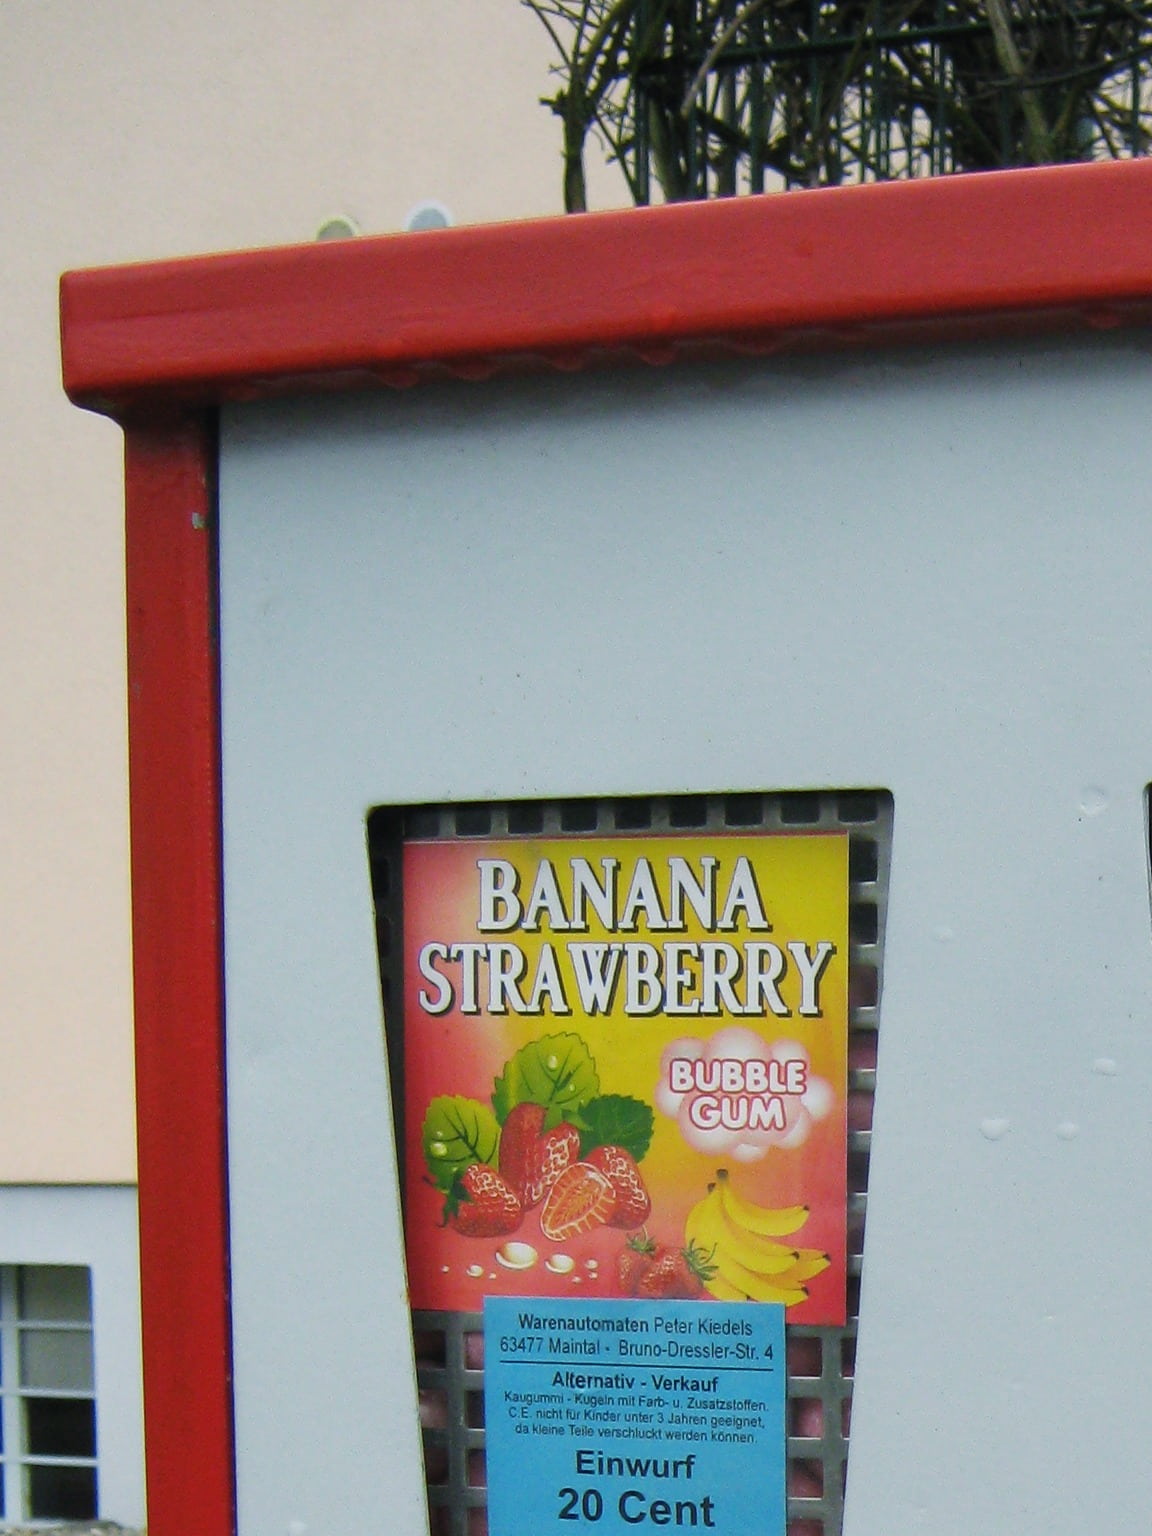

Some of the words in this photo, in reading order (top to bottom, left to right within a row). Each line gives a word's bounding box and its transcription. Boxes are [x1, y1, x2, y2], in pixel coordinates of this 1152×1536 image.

[476, 856, 773, 933] BANANA
[418, 942, 837, 1017] STRAWBERRY
[670, 1058, 807, 1095] BUBBLE
[689, 1095, 787, 1130] GUM
[519, 1313, 649, 1332] Warenautomaten
[654, 1316, 693, 1334] Peter
[698, 1318, 753, 1336] Kiedels
[500, 1336, 544, 1353] 63477
[549, 1338, 600, 1355] Maintal
[619, 1339, 760, 1361] Bruno-Dressler-Str.
[764, 1343, 774, 1361] 4
[552, 1371, 635, 1389] Alternativ
[652, 1374, 719, 1393] Verkauf
[504, 1391, 564, 1406] Kaugummi
[574, 1394, 615, 1408] Kugeln
[618, 1394, 635, 1406] mit
[638, 1396, 669, 1409] Farb-
[673, 1399, 683, 1409] u.
[687, 1397, 769, 1412] Zusatzstoffen.
[508, 1406, 532, 1419] C.E.
[536, 1407, 563, 1420] nicht
[566, 1407, 581, 1421] für
[584, 1409, 621, 1422] Kinder
[624, 1411, 654, 1424] unter
[656, 1412, 665, 1424] 3
[668, 1412, 707, 1426] Jahren
[711, 1414, 765, 1430] geeignet,
[515, 1422, 529, 1434] da
[532, 1423, 565, 1436] kleine
[568, 1424, 595, 1437] Teile
[597, 1427, 662, 1440] verschluckt
[666, 1430, 708, 1442] werden
[711, 1430, 758, 1444] können.
[576, 1450, 696, 1480] Einwurf
[557, 1487, 604, 1522] 20
[618, 1490, 716, 1527] Cent
